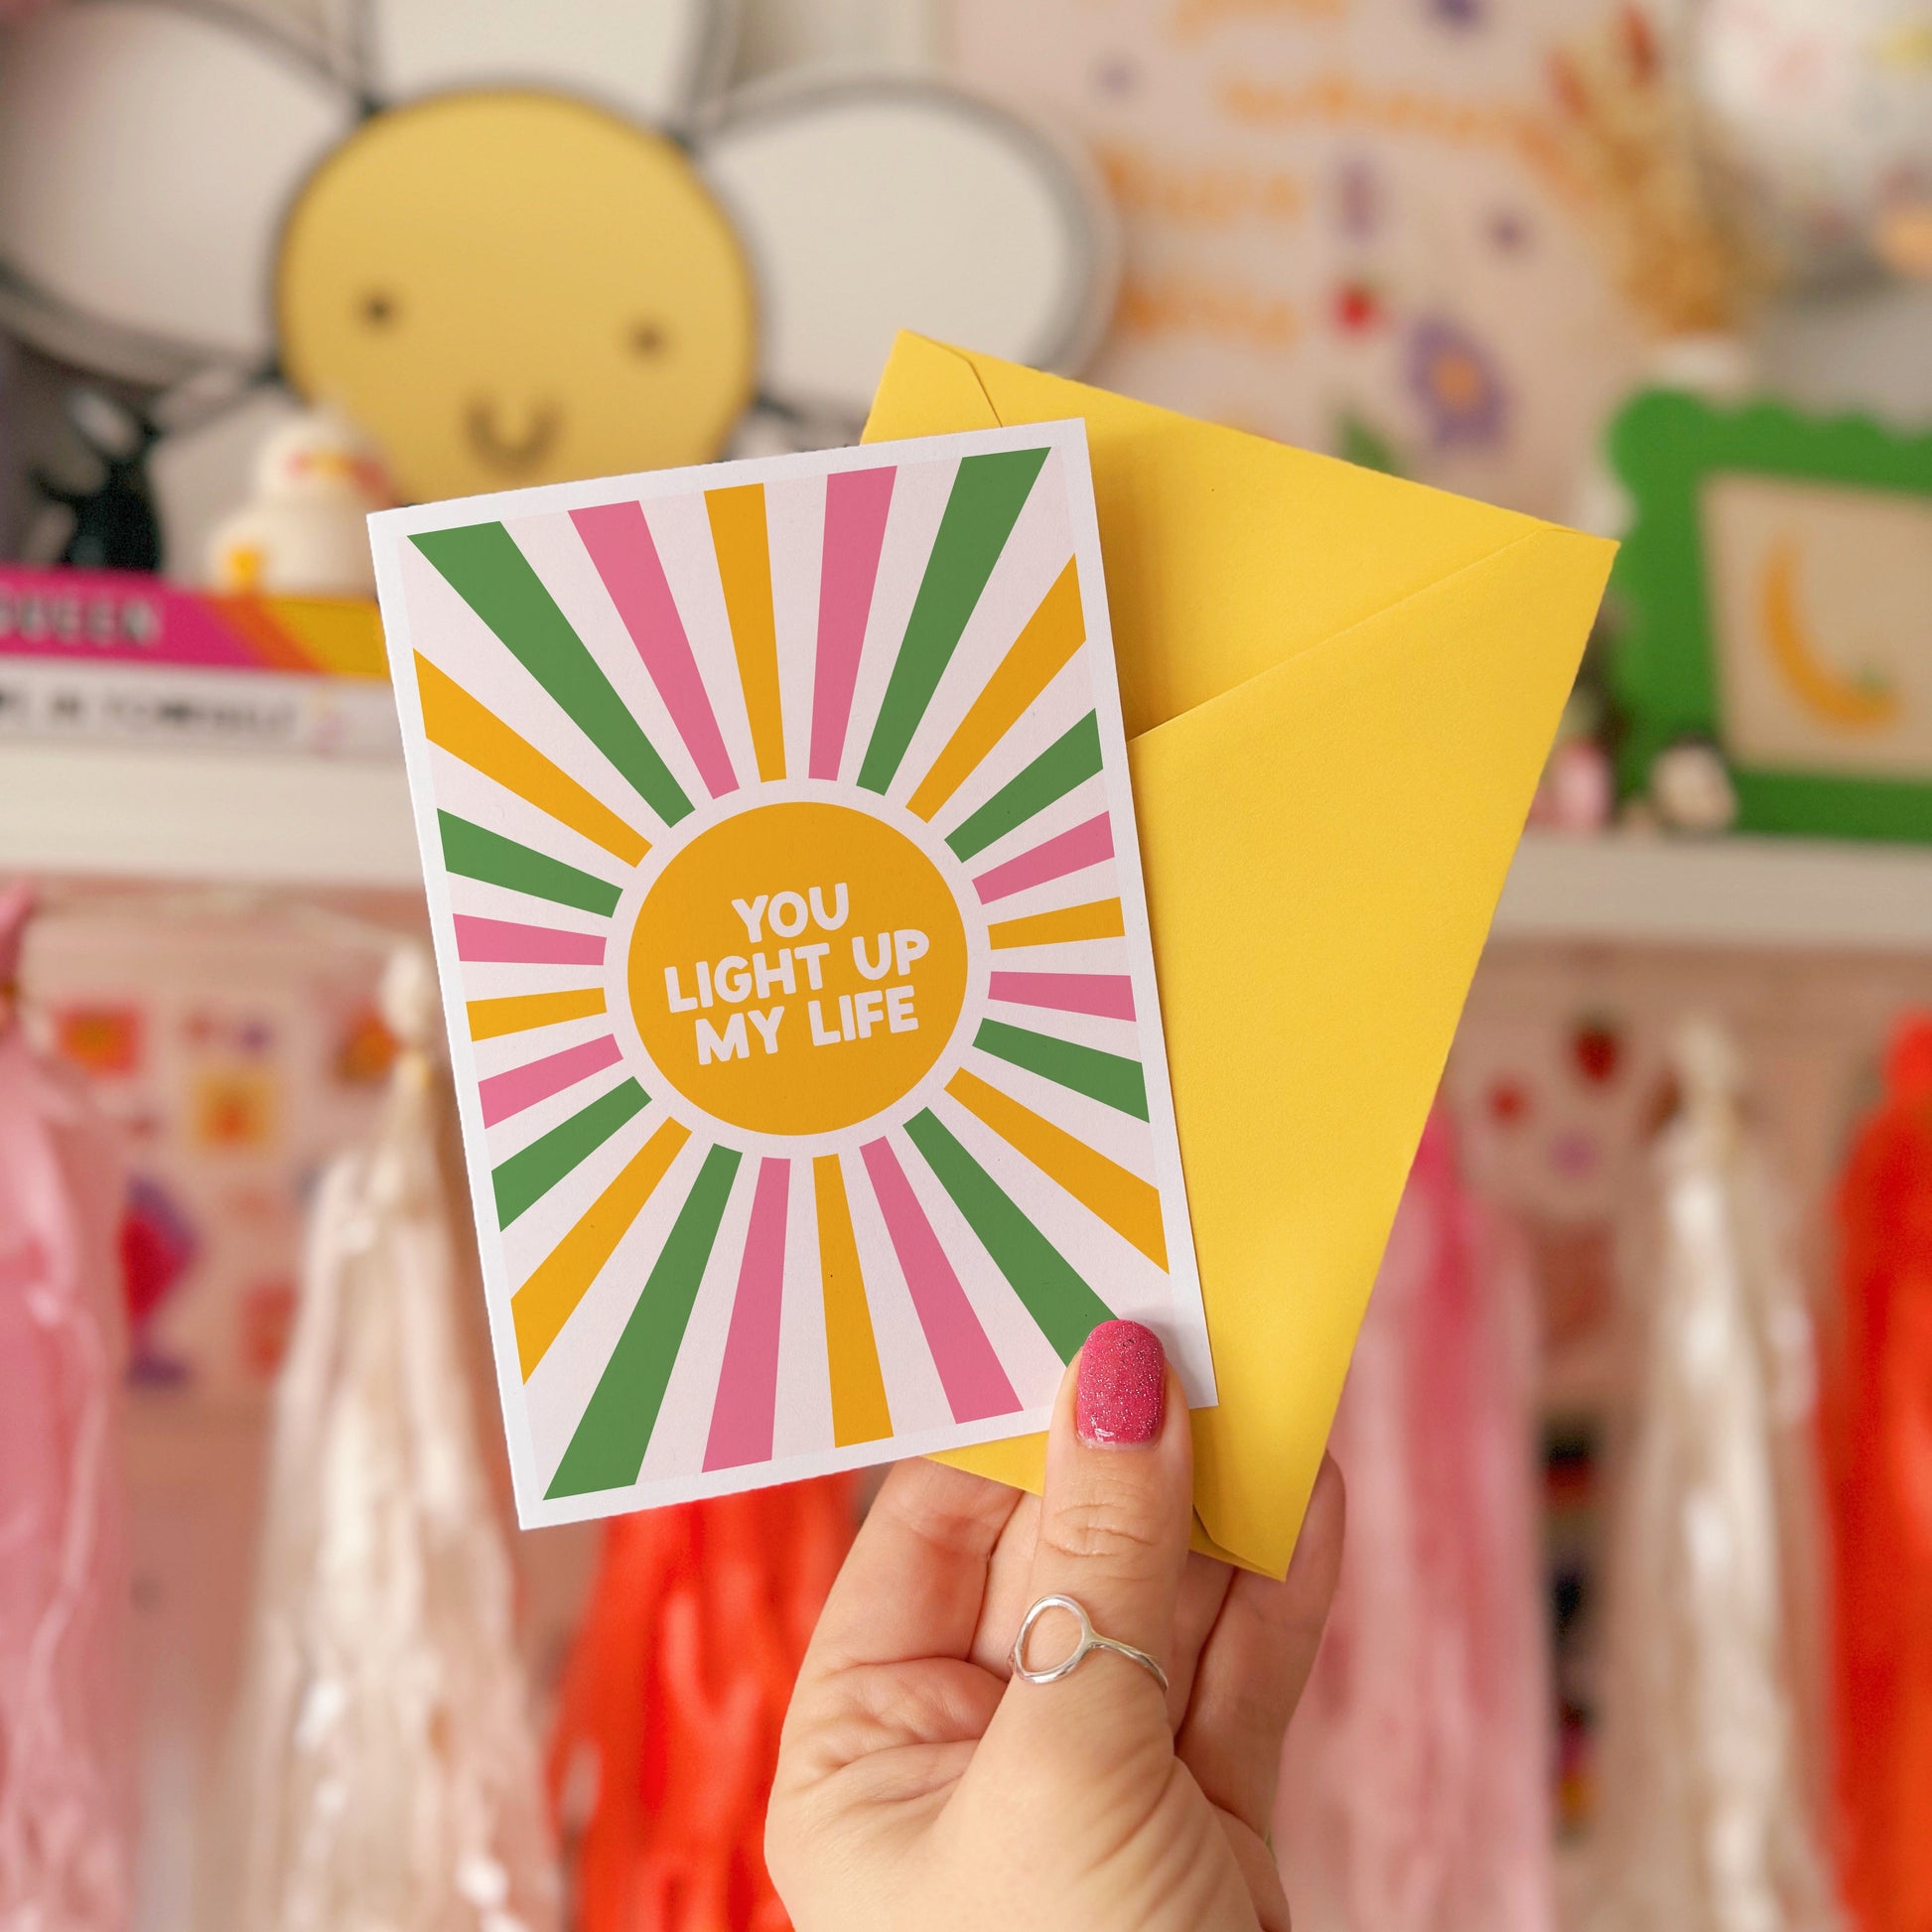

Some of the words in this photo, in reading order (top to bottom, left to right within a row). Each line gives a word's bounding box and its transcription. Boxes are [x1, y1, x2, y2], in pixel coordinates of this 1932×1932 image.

[732, 883, 849, 943] YOU
[665, 943, 830, 1013] LIGHT
[852, 929, 929, 980] UP
[695, 1006, 784, 1064] MY
[808, 985, 918, 1045] LIFE
